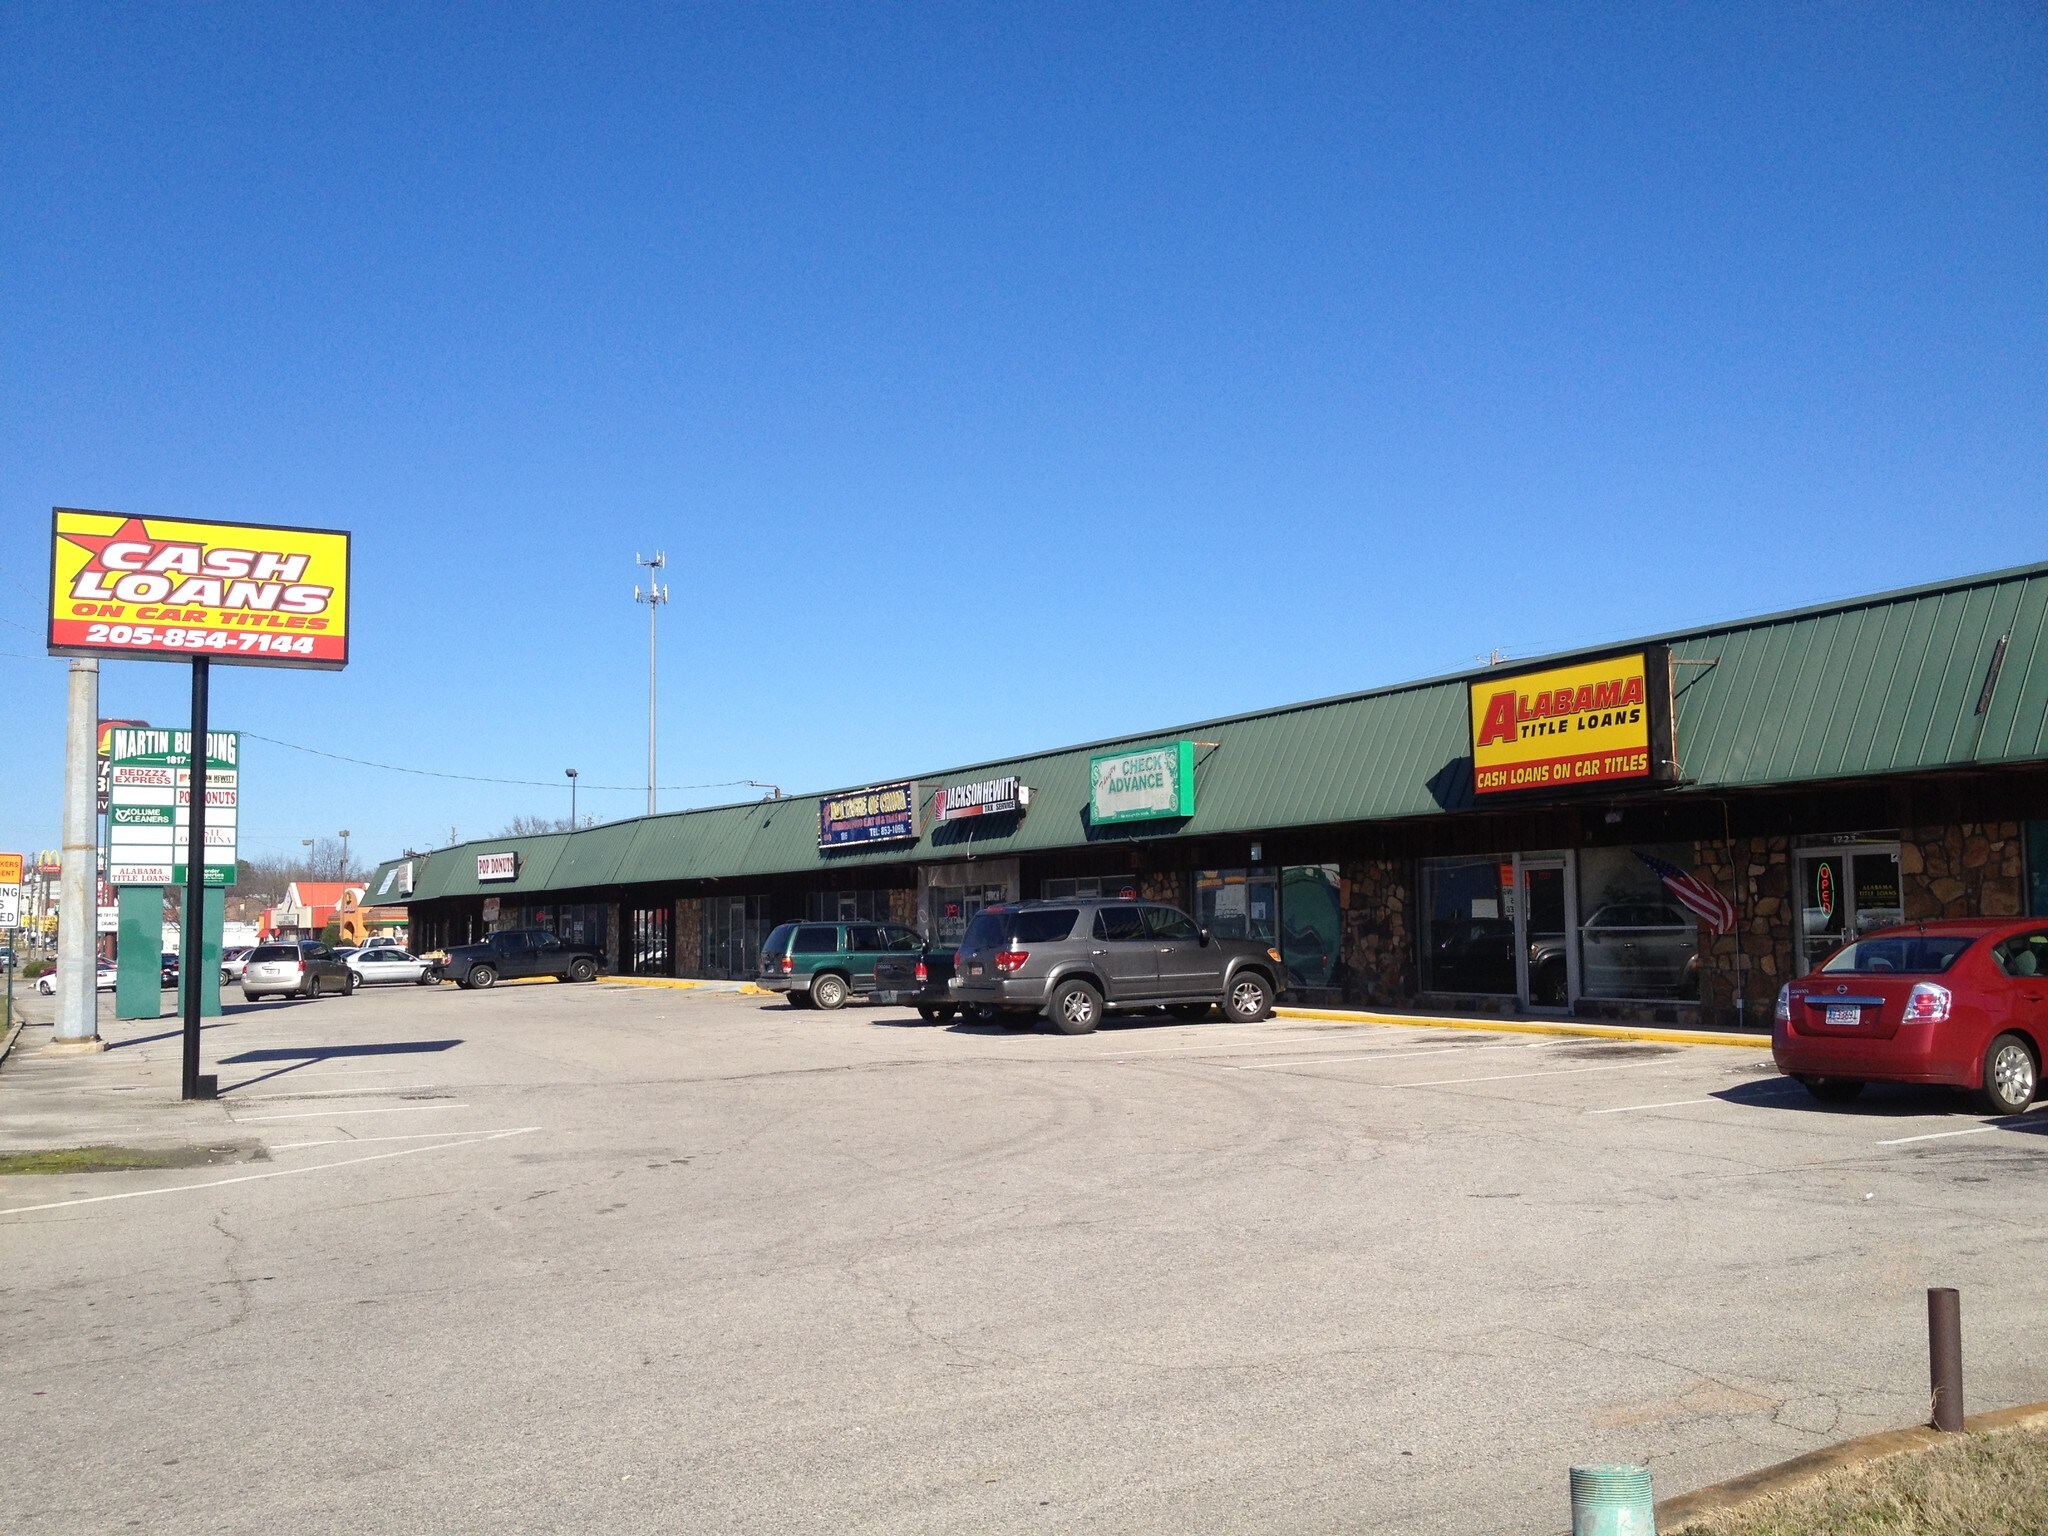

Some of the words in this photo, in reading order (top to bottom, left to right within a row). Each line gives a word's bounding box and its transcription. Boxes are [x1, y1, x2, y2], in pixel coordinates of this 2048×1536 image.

[99, 541, 310, 583] CASH
[69, 571, 334, 615] LOANS
[72, 603, 125, 617] ON
[136, 607, 208, 623] CAR
[220, 615, 329, 634] TITLES
[86, 624, 314, 654] 205-854-7144
[1477, 676, 1644, 747] ALABAMA
[1521, 720, 1569, 738] TITLE
[1577, 709, 1640, 731] LOANS
[115, 730, 169, 761] MARTIN
[175, 732, 237, 765] BUDING
[166, 756, 187, 764] 1817
[120, 768, 167, 777] BEDZZZ
[1122, 755, 1163, 776] CHECK
[1477, 772, 1507, 788] CASH
[1510, 765, 1549, 785] LOANS
[1553, 762, 1571, 780] ON
[1574, 759, 1600, 776] CAR
[1604, 753, 1648, 774] TITLES
[115, 776, 170, 785] EXPRESS
[1108, 773, 1164, 794] ADVANCE
[179, 790, 191, 804] PO
[206, 791, 236, 805] ONUTS
[984, 803, 994, 812] TAX
[996, 801, 1015, 811] SERVICE
[1832, 835, 1856, 844] 1723
[479, 859, 490, 874] POP
[491, 857, 514, 873] DONUTS
[1820, 866, 1831, 914] OPEN
